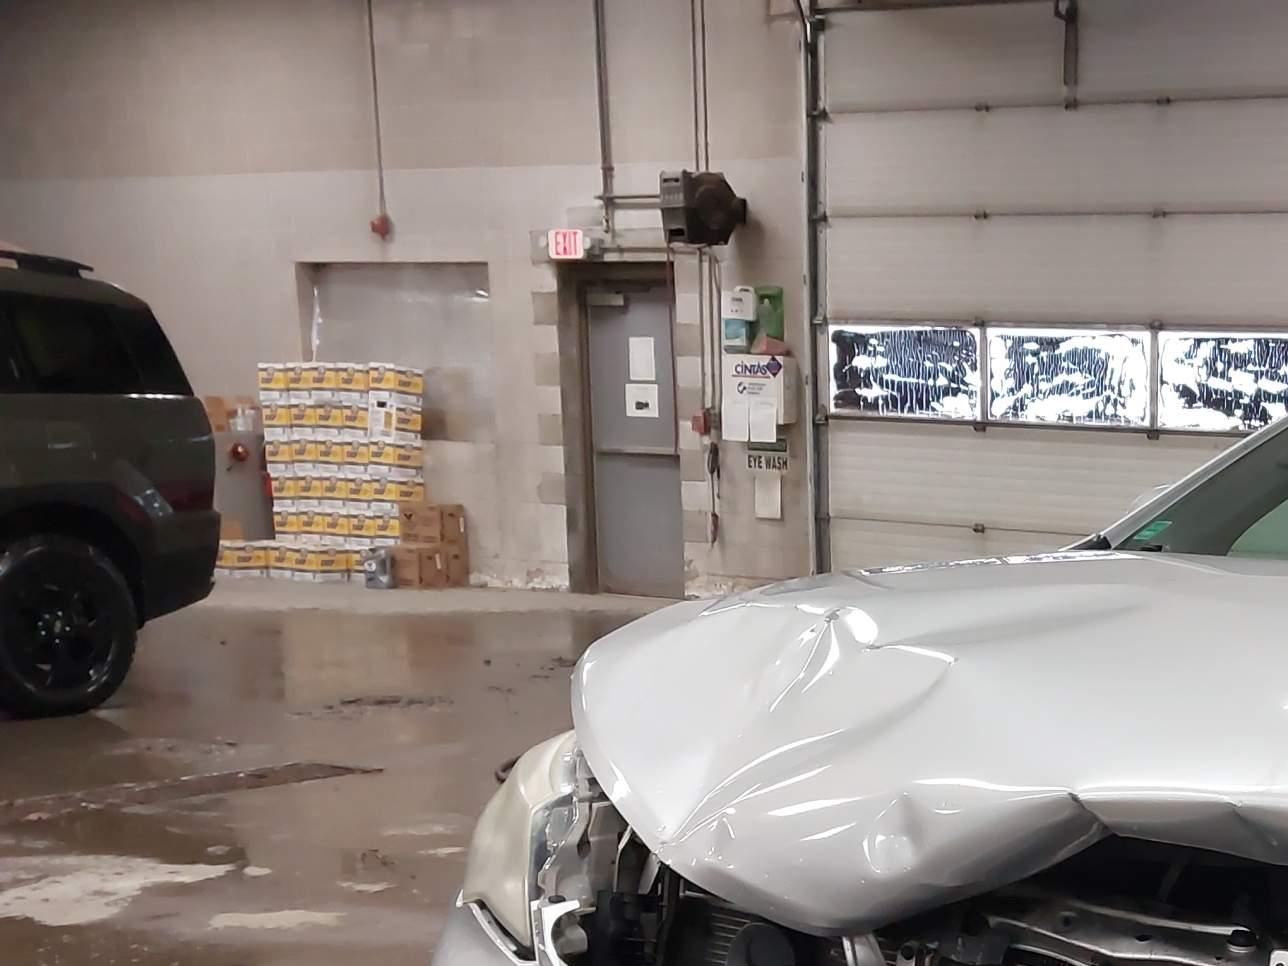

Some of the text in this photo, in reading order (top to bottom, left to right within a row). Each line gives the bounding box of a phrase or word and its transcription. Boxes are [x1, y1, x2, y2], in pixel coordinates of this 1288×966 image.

[555, 231, 577, 256] EXIT
[747, 455, 788, 470] EYE WASH
